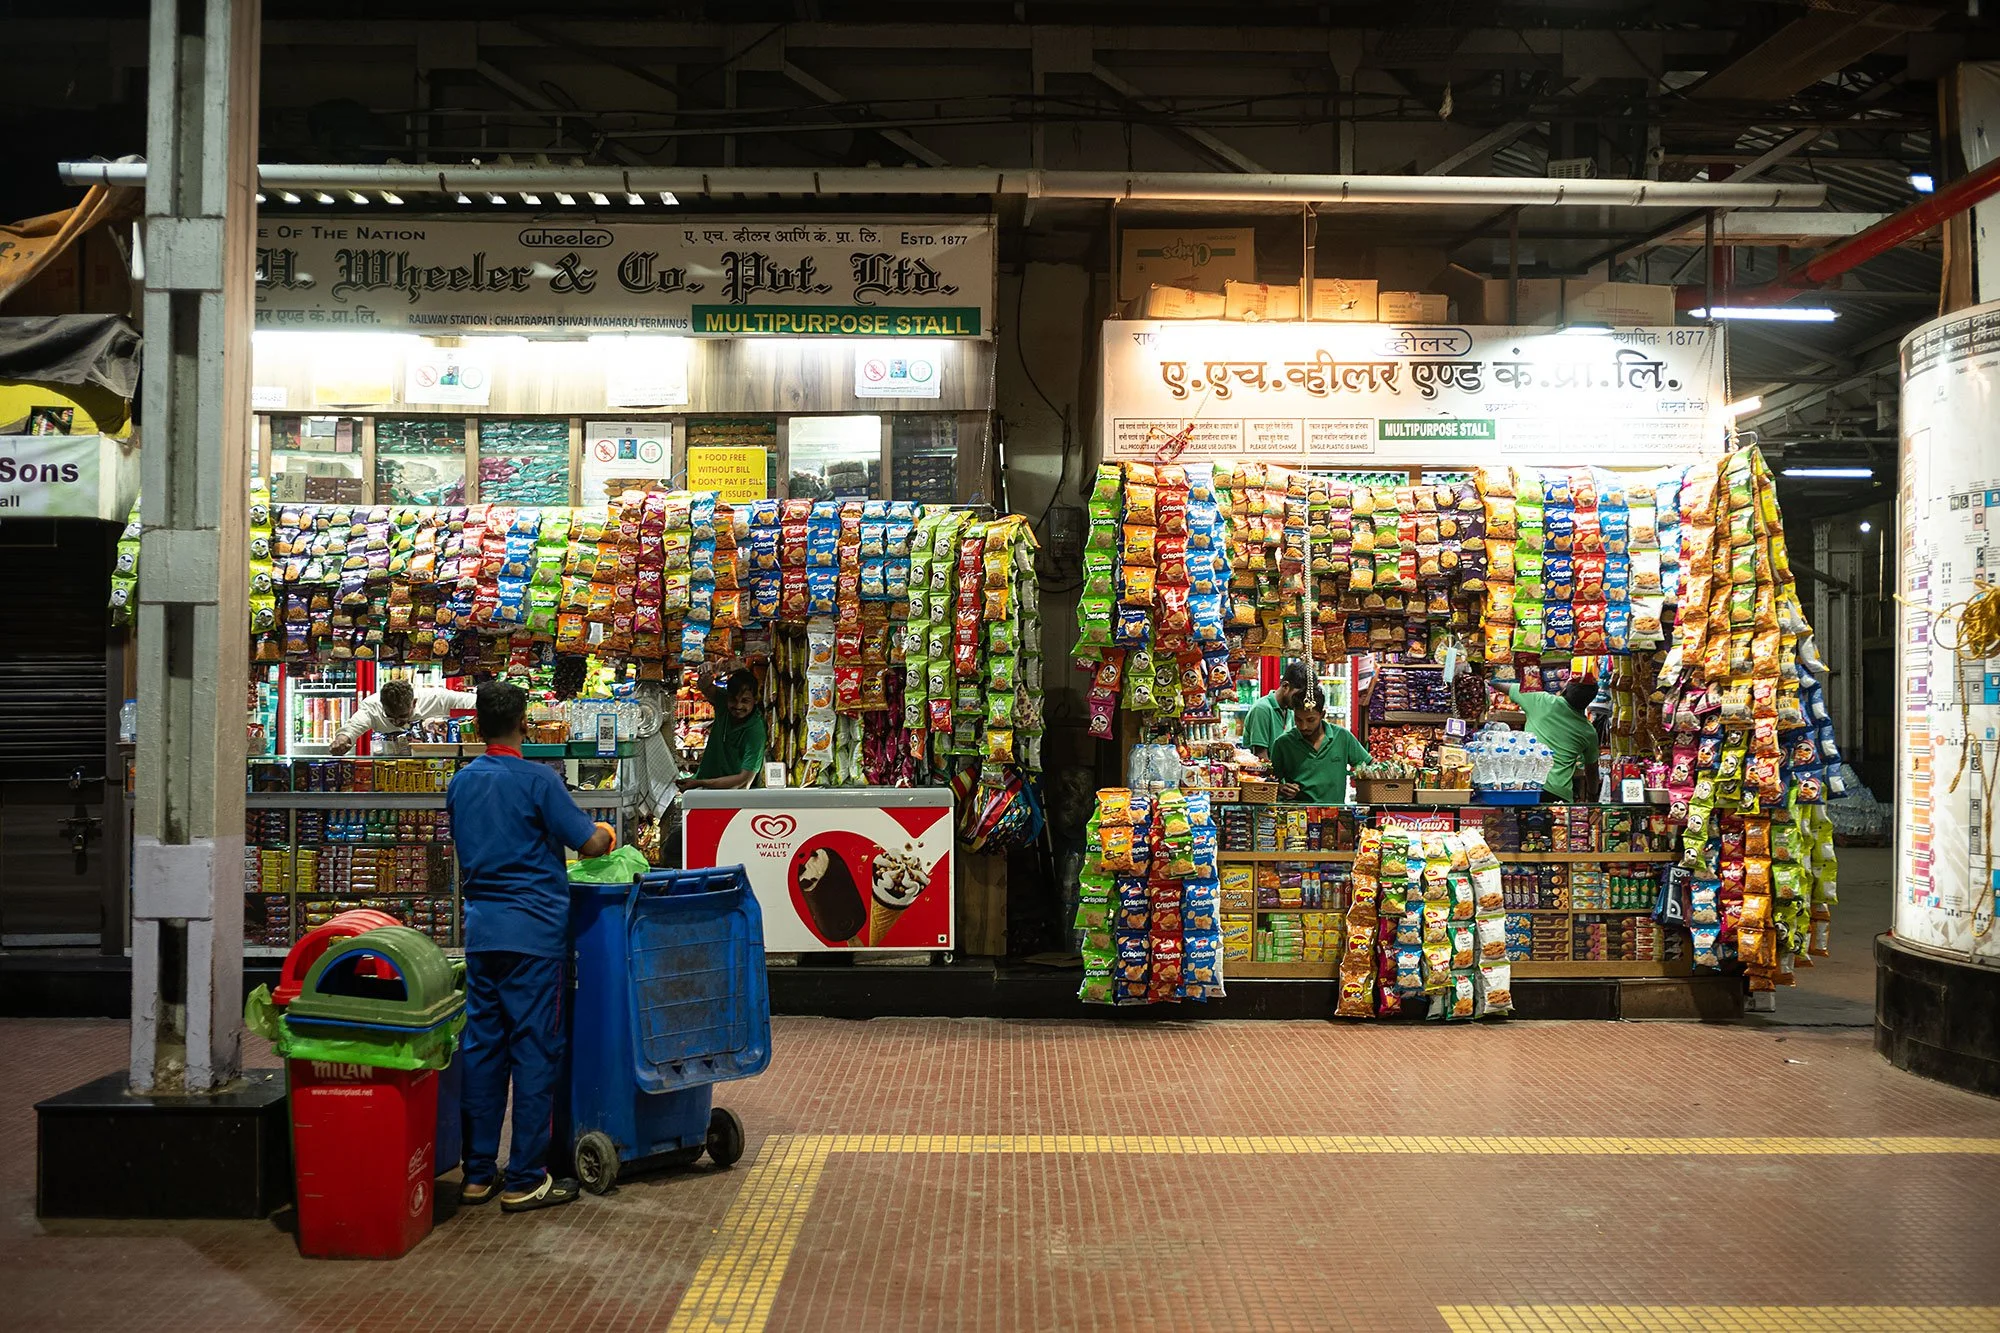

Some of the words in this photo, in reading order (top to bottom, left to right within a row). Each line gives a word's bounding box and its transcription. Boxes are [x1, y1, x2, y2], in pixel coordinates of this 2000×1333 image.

[525, 230, 608, 247] wheeler
[941, 235, 968, 245] 1877
[331, 247, 535, 304] Wheeler
[549, 251, 598, 294] &
[616, 250, 706, 295] Co.
[720, 250, 833, 305] Pvt.
[850, 251, 959, 307] Ltd.
[408, 313, 449, 325] RAILWAY
[450, 314, 487, 326] STATION
[494, 315, 556, 327] CHHATRAPATI
[557, 316, 592, 328] SHIVAJI
[593, 317, 638, 328] MAHARAJ
[639, 318, 688, 329] TERMINUS
[705, 311, 890, 334] MULTIPURPOSE
[896, 314, 970, 335] STALL
[1667, 330, 1705, 346] 1877
[1409, 361, 1486, 400] एण्ड
[1384, 422, 1459, 437] MULTIPURPOSE
[1459, 422, 1489, 437] STALL
[705, 453, 728, 462] FOOD
[729, 453, 747, 462] FREE
[0, 457, 79, 483] Sons
[698, 466, 734, 474] WITHOUT
[736, 466, 750, 474] BILL
[698, 478, 723, 486] DON'T
[724, 478, 739, 486] PAY
[740, 478, 747, 486] IF
[749, 478, 763, 486] BILL
[725, 490, 752, 498] ISSUED
[756, 842, 792, 850] KWALITY
[1192, 845, 1215, 855] rispies
[759, 850, 788, 858] WALL'S
[1224, 873, 1249, 885] MONACO
[1234, 900, 1248, 908] Jack
[1223, 926, 1249, 937] MONACO
[1223, 948, 1249, 959] MONACO
[1085, 969, 1110, 977] Crispies
